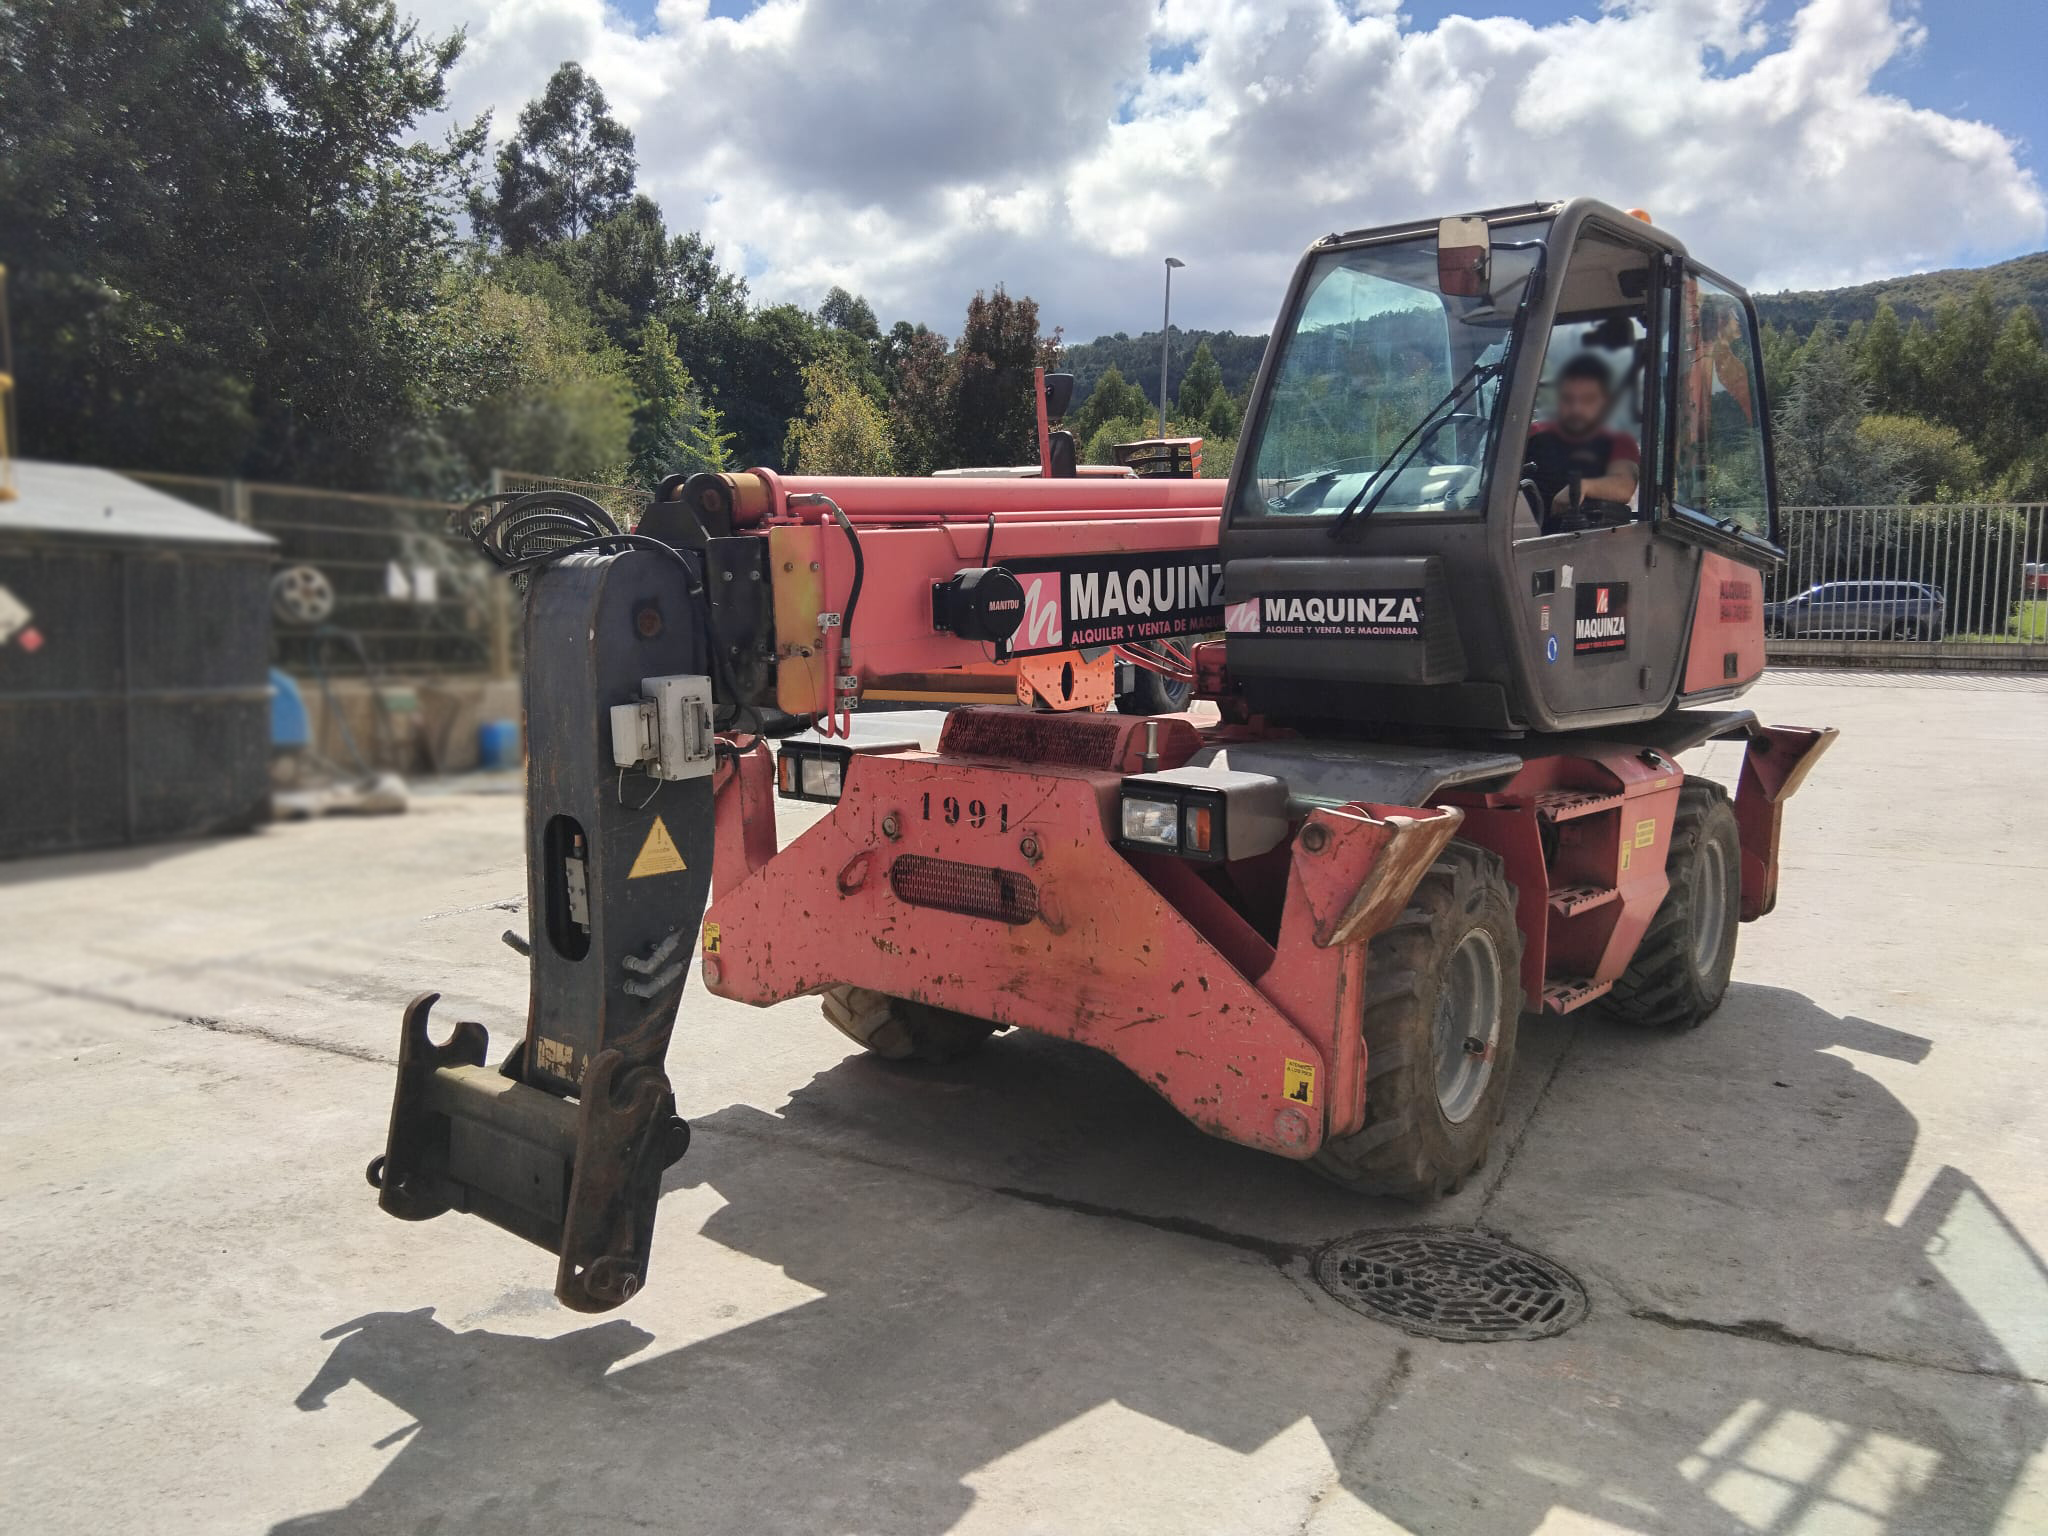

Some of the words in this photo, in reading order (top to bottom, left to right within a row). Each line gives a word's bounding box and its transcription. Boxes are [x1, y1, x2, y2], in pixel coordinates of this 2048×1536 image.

[989, 600, 1020, 610] MANITOU
[1265, 598, 1419, 623] MAQUINZA
[1071, 626, 1124, 645] ALQUILER
[1127, 624, 1135, 638] Y
[1138, 621, 1171, 636] VENTA
[1174, 619, 1186, 632] DE
[1266, 626, 1304, 634] ALQUILER
[1306, 626, 1312, 634] Y
[1315, 626, 1342, 634] VENTA
[1344, 626, 1356, 634] DE
[1358, 627, 1418, 635] MAQUINARIA
[1576, 617, 1625, 638] MAQUINZA
[920, 792, 1008, 833] 1991
